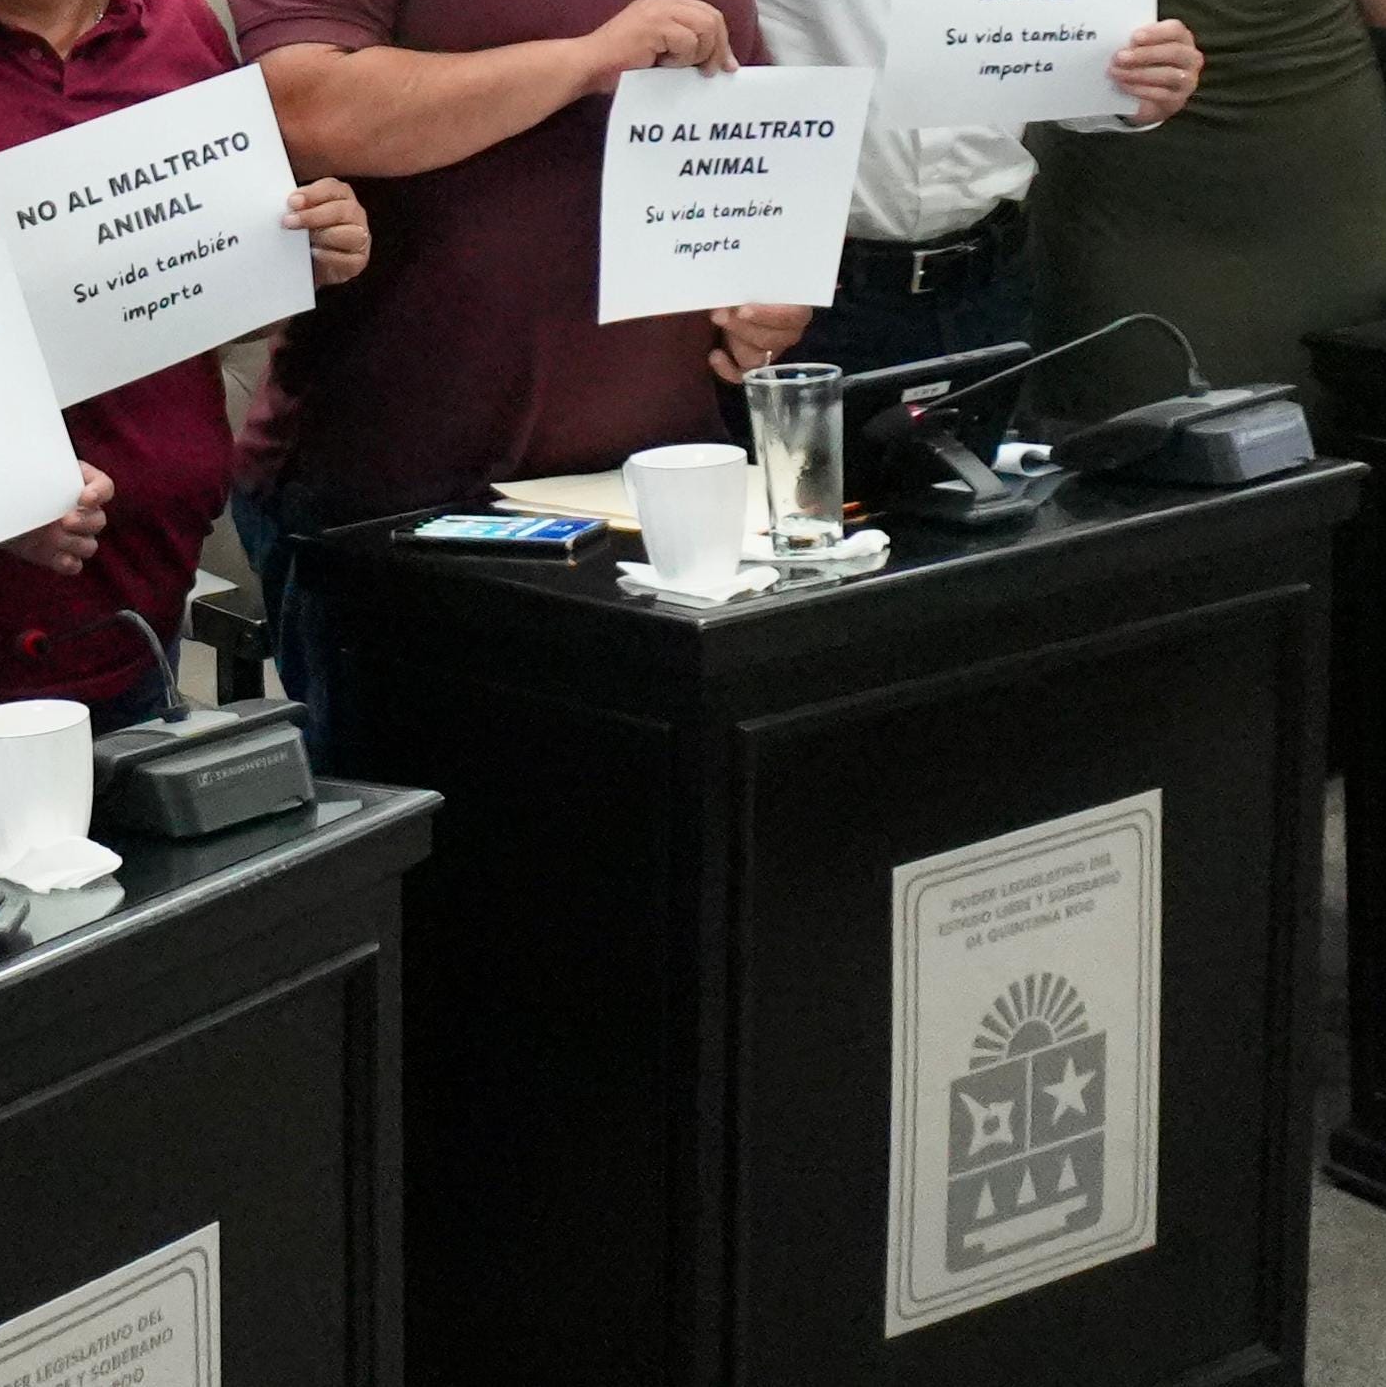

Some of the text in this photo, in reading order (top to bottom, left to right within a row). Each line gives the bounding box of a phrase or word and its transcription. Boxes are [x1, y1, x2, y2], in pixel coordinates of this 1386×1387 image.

[946, 24, 1097, 46] Su vida también
[979, 60, 1053, 81] importa
[629, 120, 835, 143] NO AL MALTRATO
[16, 132, 249, 230] NO AL MALTRATO
[679, 156, 769, 177] ANIMAL
[98, 193, 203, 245] ANIMAL
[646, 200, 783, 224] Su vida también
[674, 237, 740, 260] importa
[73, 231, 239, 304] Su vida también
[122, 283, 203, 322] importa
[35, 1309, 164, 1384] LEGISLATIVO DEL
[91, 1327, 173, 1377] SOBERANO
